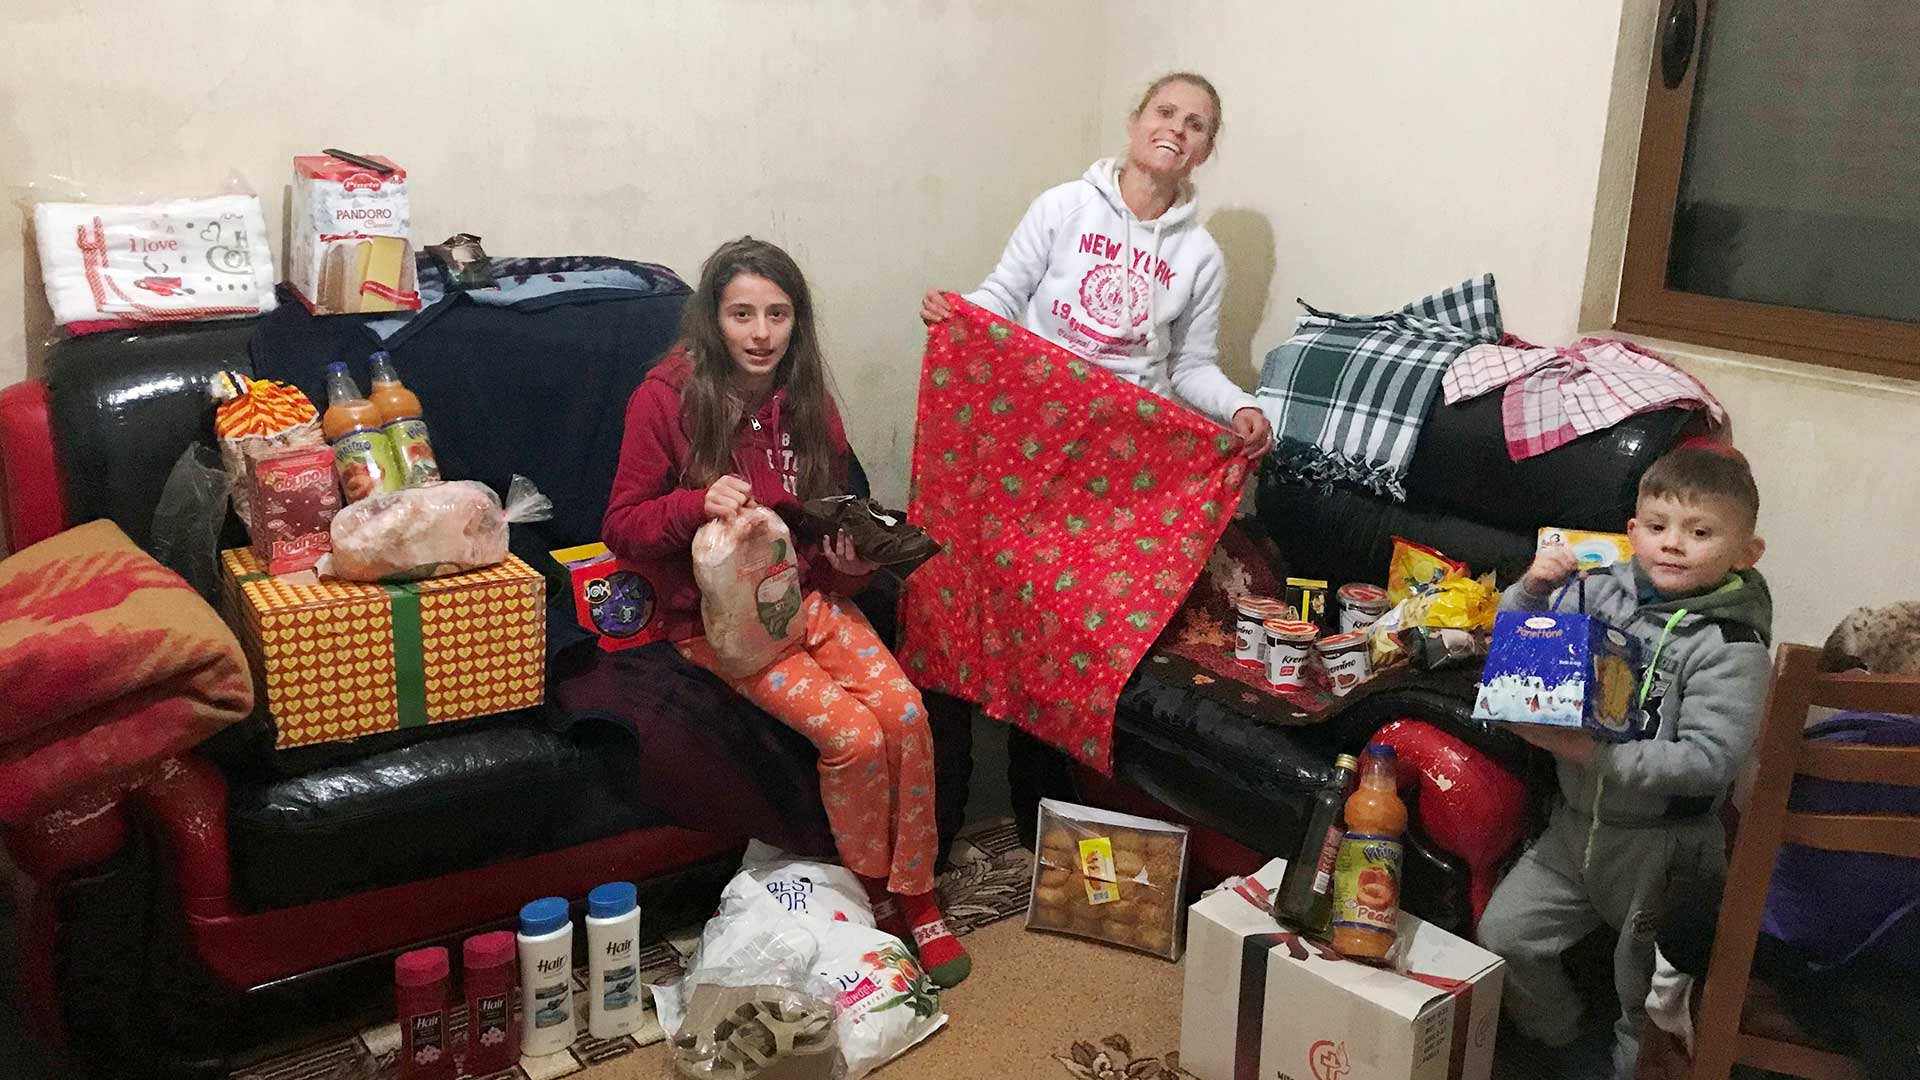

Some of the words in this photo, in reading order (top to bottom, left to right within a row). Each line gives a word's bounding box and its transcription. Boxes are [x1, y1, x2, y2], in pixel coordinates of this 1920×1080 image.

[336, 208, 392, 220] PANDORO
[141, 238, 178, 253] love
[1078, 232, 1122, 261] NEW
[272, 531, 330, 559] Rodrigo
[606, 940, 634, 955] Hair
[537, 956, 567, 973] Hair
[482, 999, 505, 1011] Hair
[416, 1016, 440, 1029] Hair
